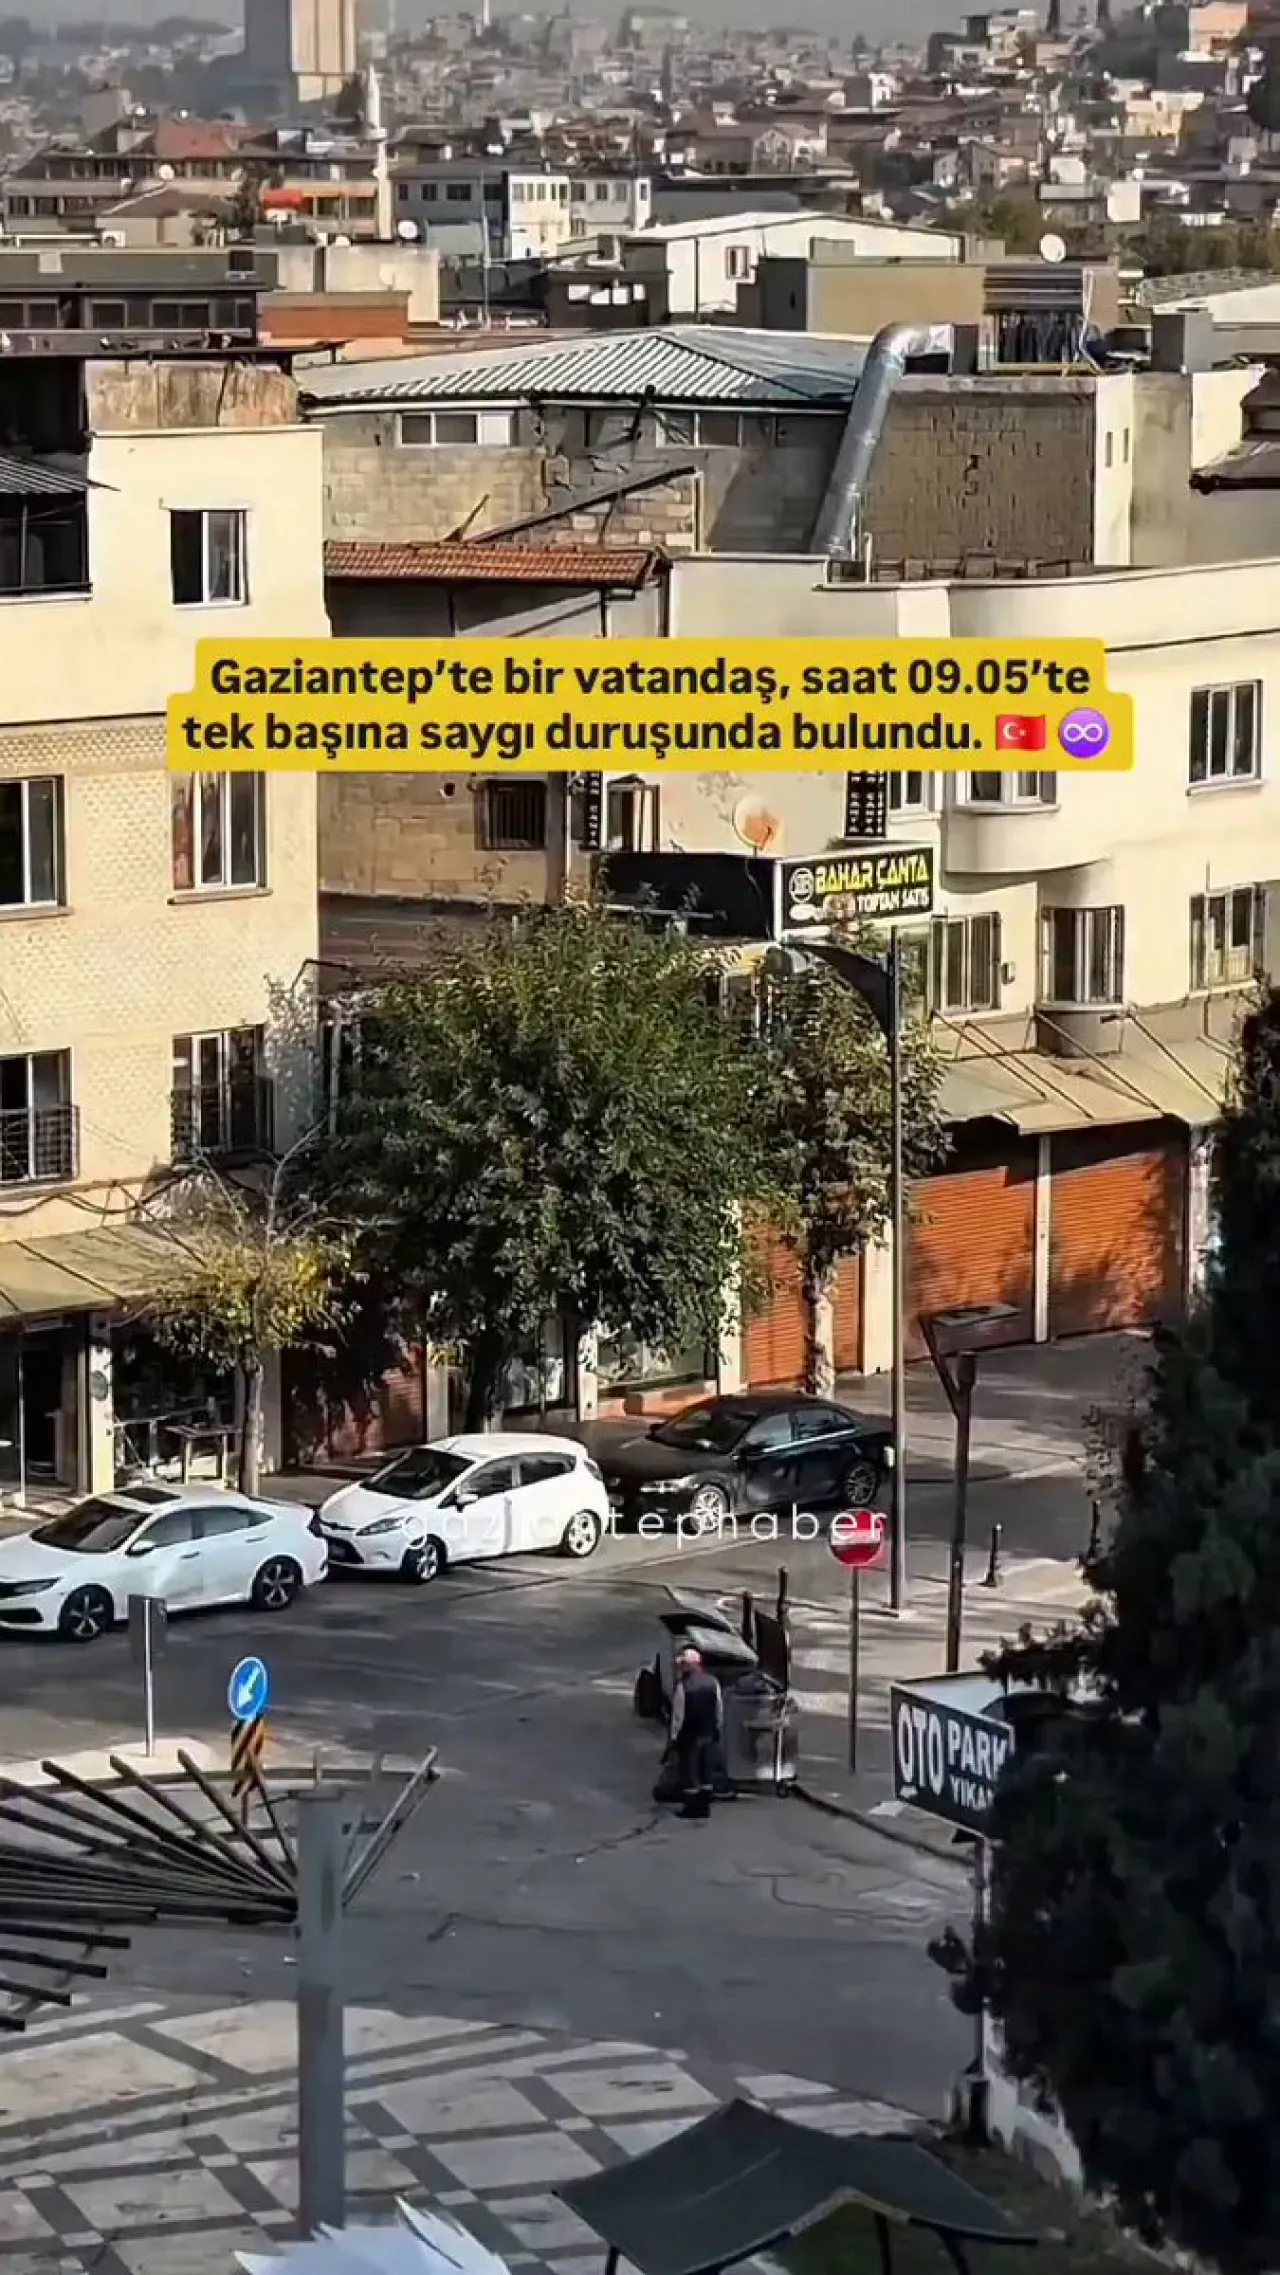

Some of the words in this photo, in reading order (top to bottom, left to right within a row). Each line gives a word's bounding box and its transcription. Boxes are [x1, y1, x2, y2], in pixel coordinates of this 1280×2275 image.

[815, 861, 874, 894] BAHAR
[876, 854, 929, 890] ÇANTA
[898, 1700, 945, 1796] OTO
